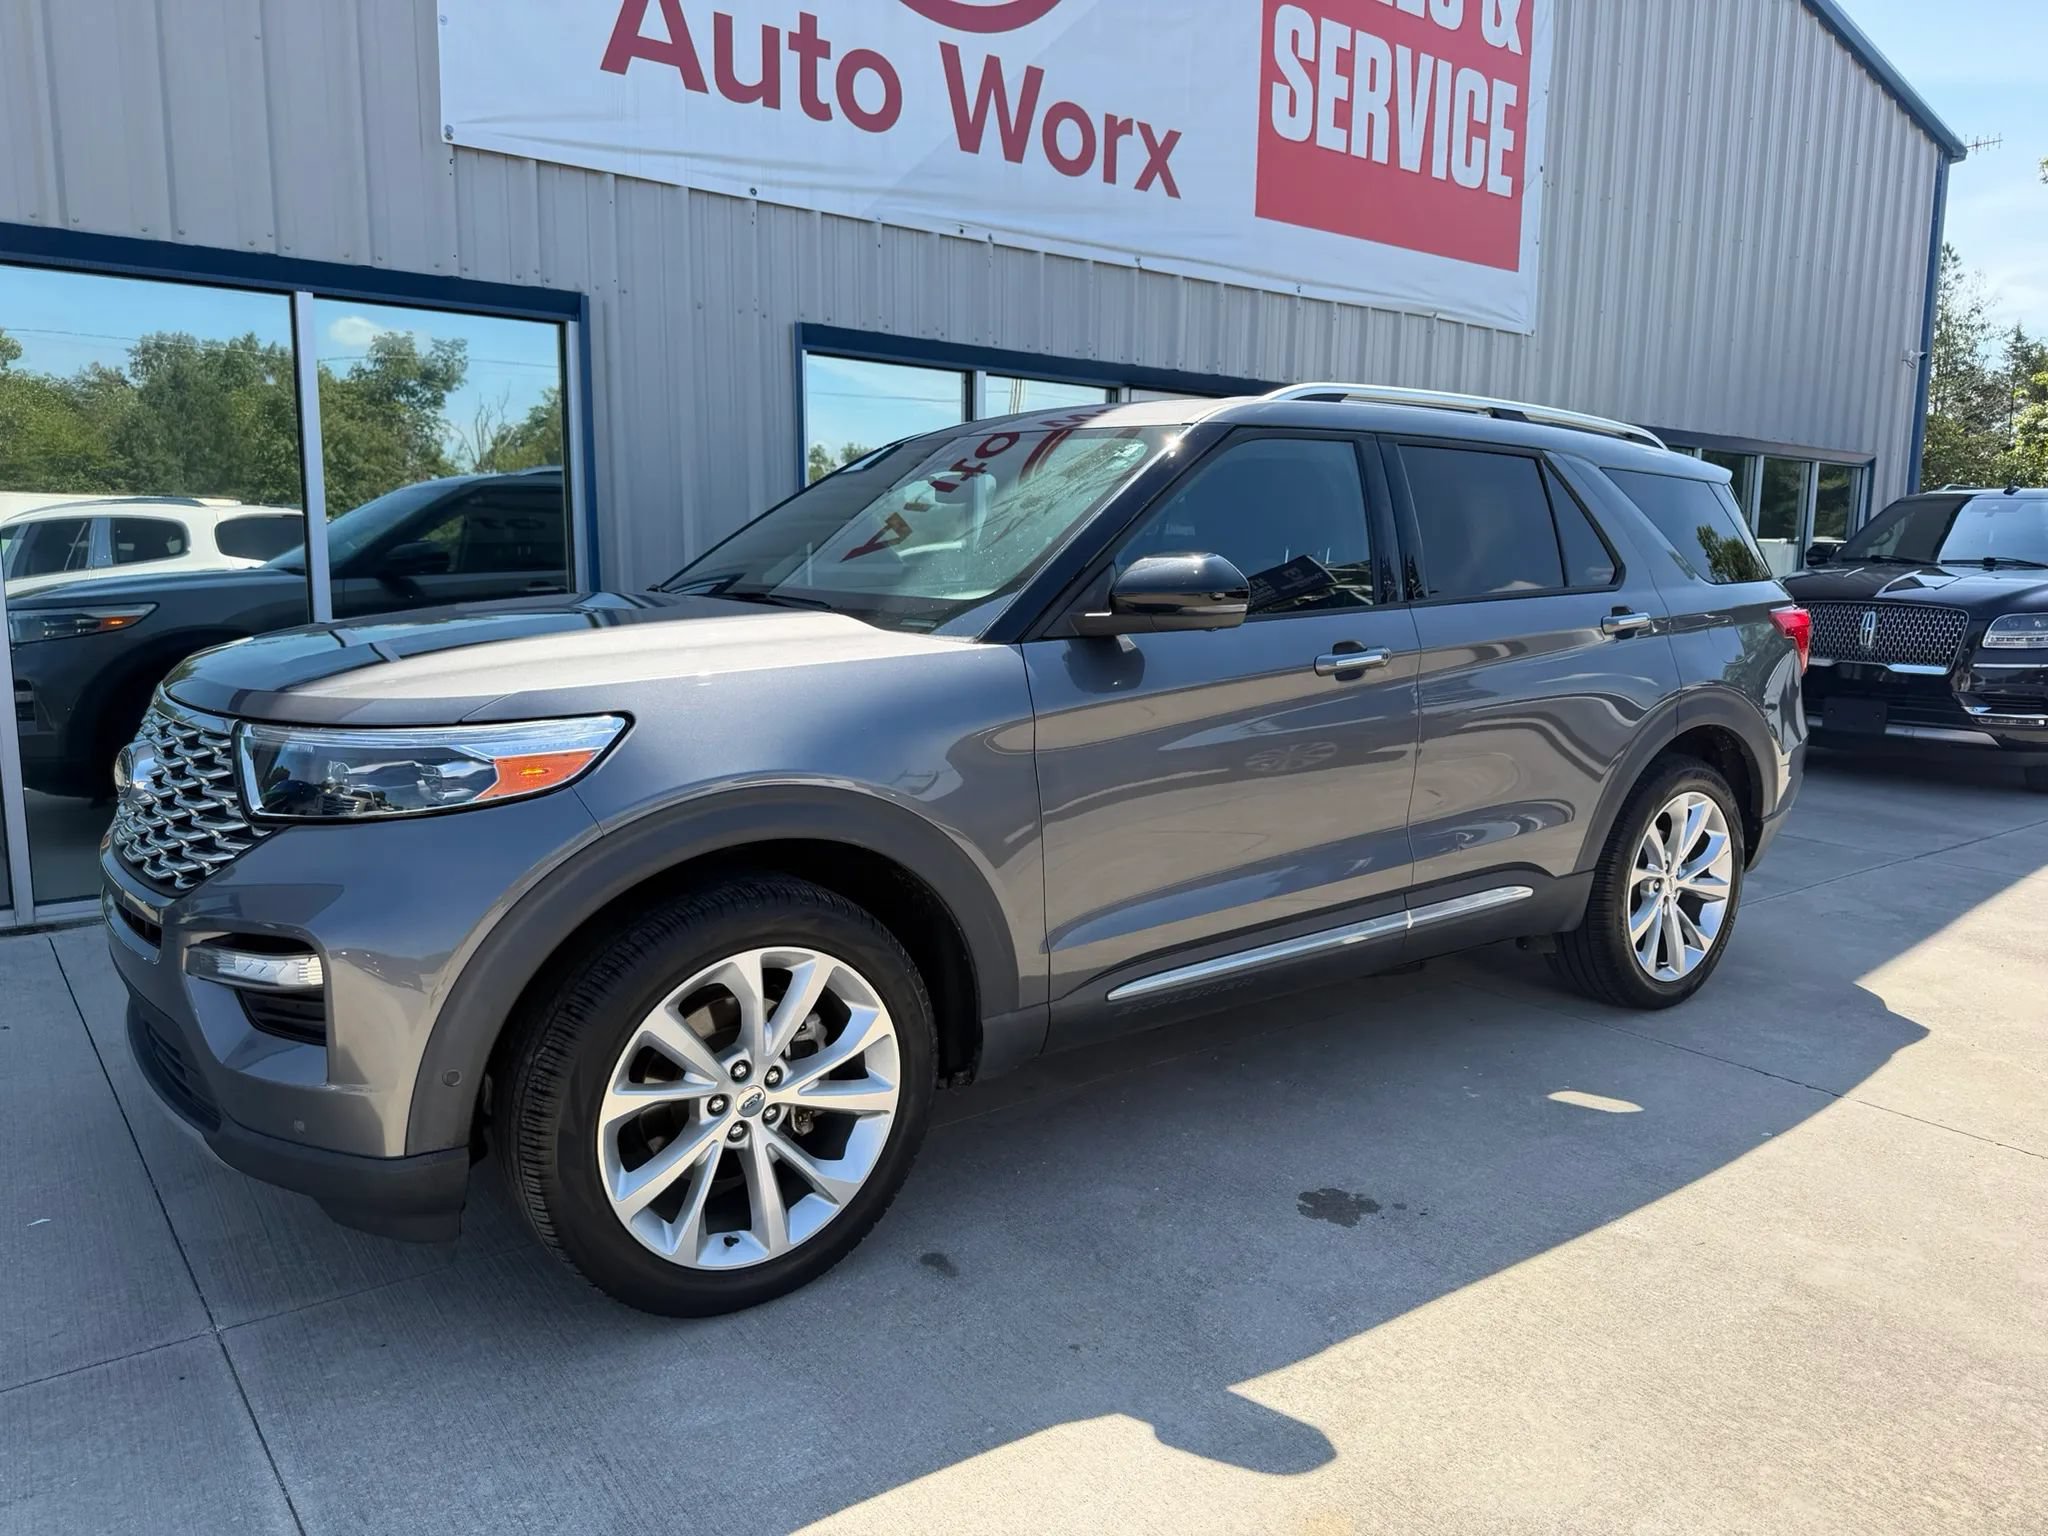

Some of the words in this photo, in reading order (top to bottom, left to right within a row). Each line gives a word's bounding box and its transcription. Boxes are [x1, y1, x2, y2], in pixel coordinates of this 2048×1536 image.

[600, 0, 902, 133] Auto
[940, 42, 1181, 199] Worx
[1271, 4, 1517, 198] SERVICE
